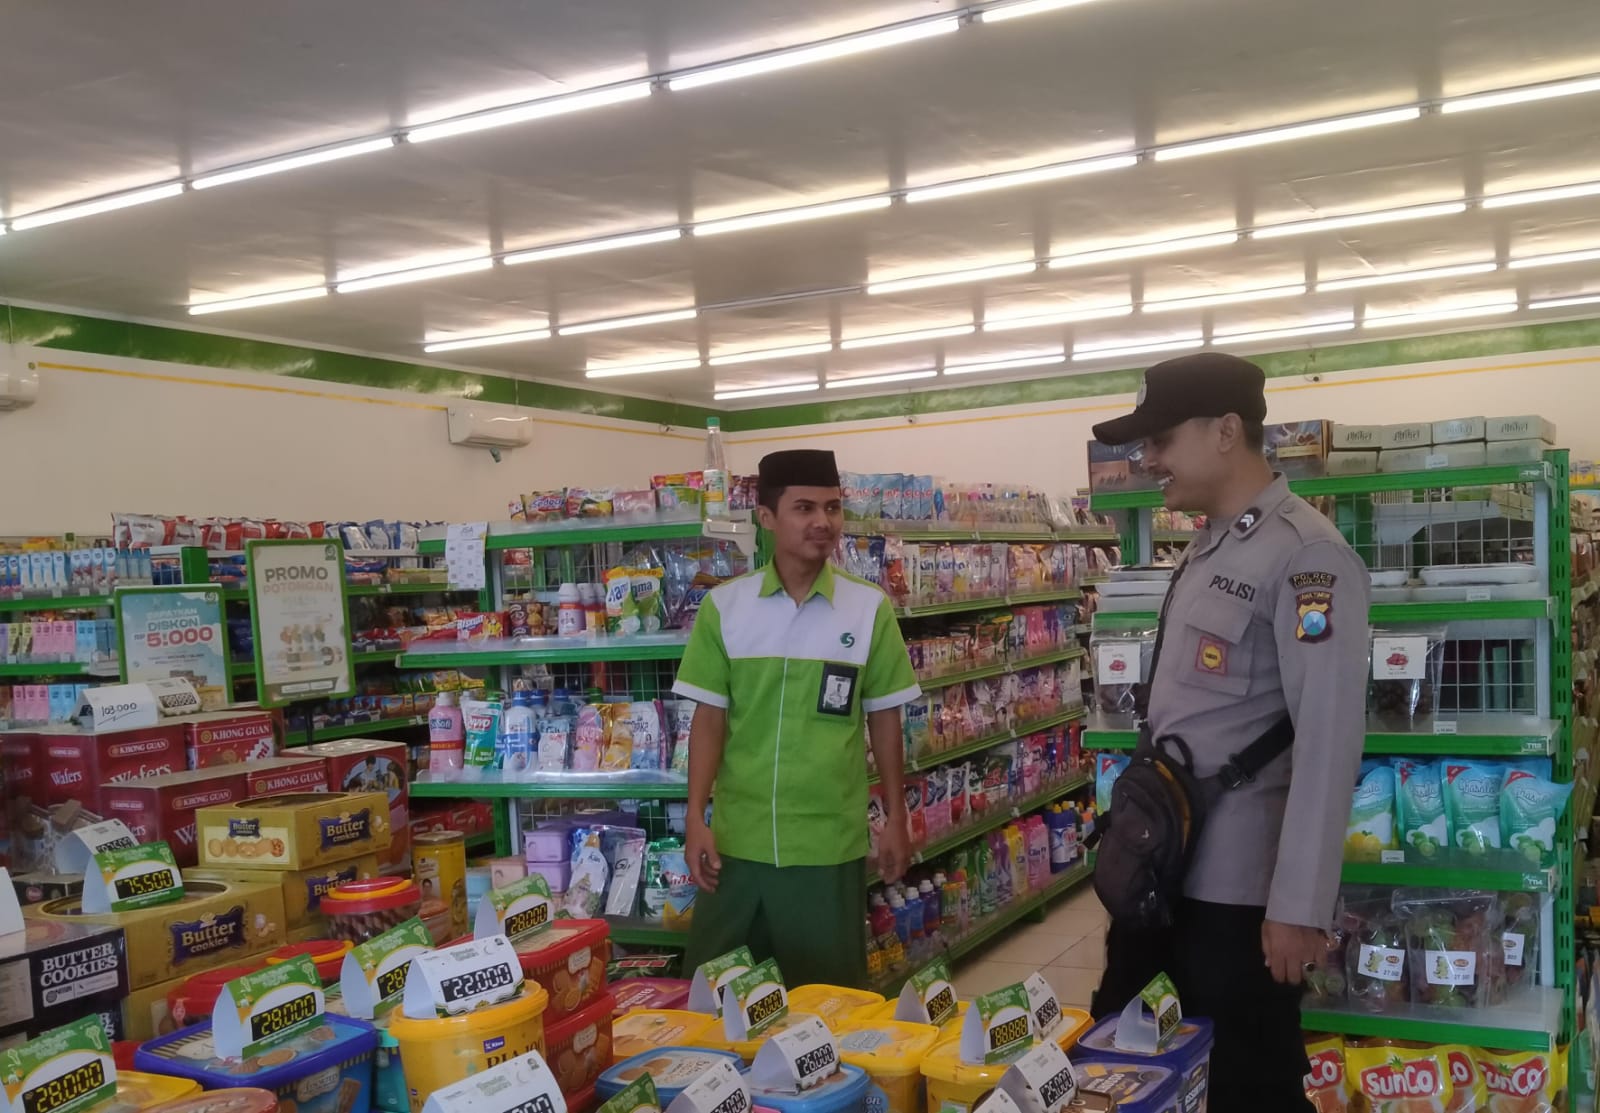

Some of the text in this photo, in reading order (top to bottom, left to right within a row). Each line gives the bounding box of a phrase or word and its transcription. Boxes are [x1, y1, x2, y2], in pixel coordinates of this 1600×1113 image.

[264, 565, 329, 582] PROMO
[263, 581, 334, 595] POTONGAN
[1208, 575, 1256, 602] POLISI
[147, 617, 198, 632] DISKON
[212, 723, 270, 741] KHONG GUAN
[119, 740, 166, 754] KHONG GUAN
[50, 768, 82, 786] Wafers
[266, 771, 325, 790] KHONG GUAN
[183, 790, 230, 807] KHONG GUAN
[232, 822, 257, 831] Butter
[326, 819, 366, 837] Butter
[332, 831, 360, 843] cookies
[124, 870, 173, 894] 75.500
[510, 904, 547, 935] 28.000
[181, 920, 237, 947] Butter
[190, 935, 229, 954] cookies
[41, 942, 115, 973] BUTTER
[40, 955, 119, 988] COOKIES
[452, 964, 511, 998] 22.000
[261, 995, 315, 1035] 28.000
[35, 1062, 103, 1113] 28.000
[1367, 1064, 1433, 1097] SunCo
